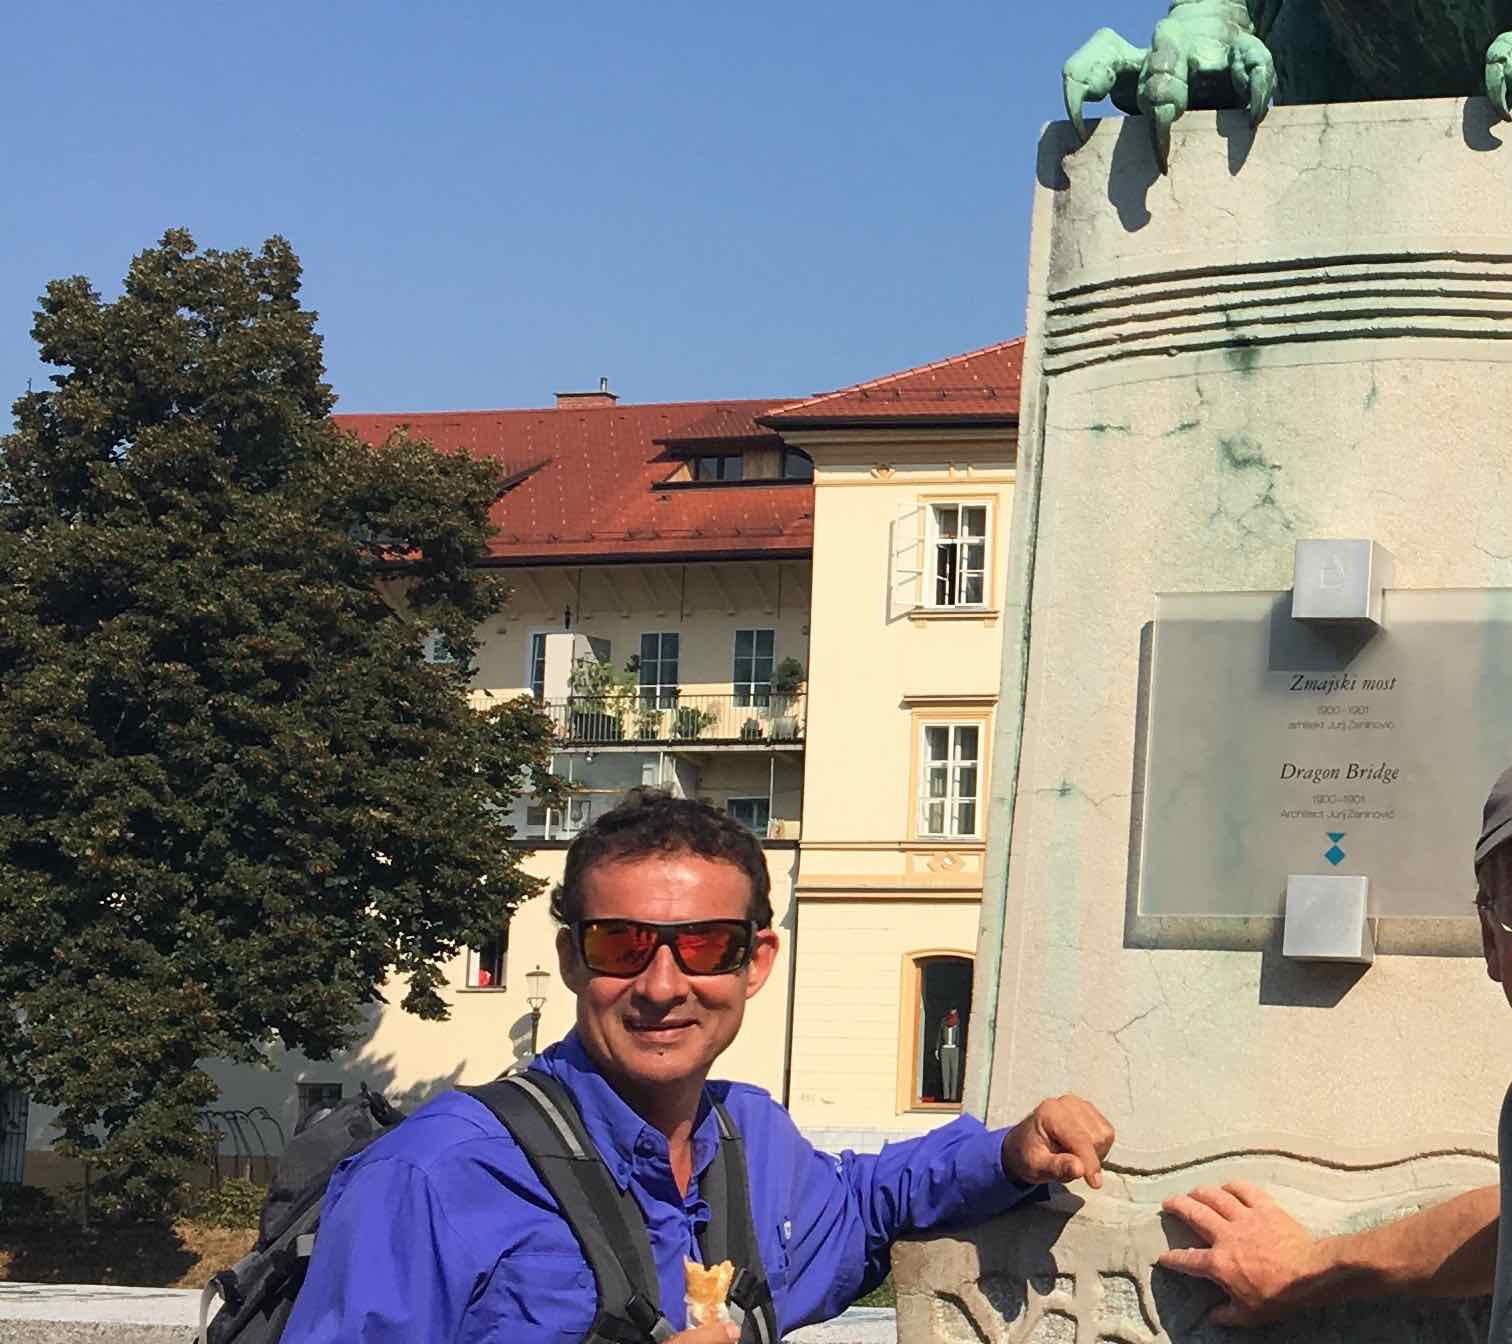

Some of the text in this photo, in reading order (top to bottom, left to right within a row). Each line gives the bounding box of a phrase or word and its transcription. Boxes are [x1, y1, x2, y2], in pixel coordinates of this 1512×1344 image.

[1289, 673, 1397, 695] Zmajski most
[1280, 762, 1400, 784] Dragon Bridge
